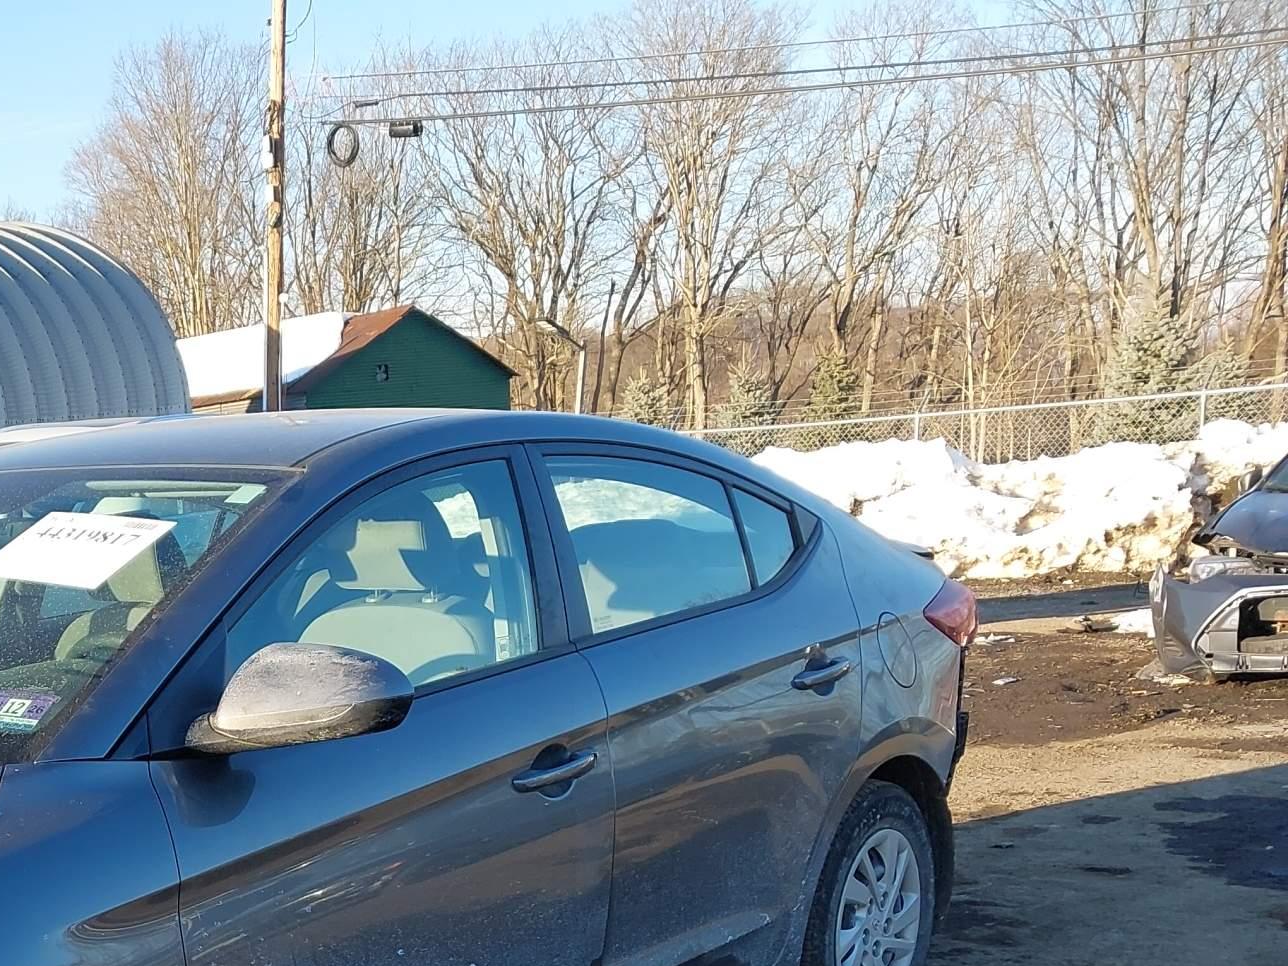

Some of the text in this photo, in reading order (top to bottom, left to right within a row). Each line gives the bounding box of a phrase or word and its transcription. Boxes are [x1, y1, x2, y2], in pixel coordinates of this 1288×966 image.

[36, 526, 142, 546] 44319817
[2, 701, 26, 715] 12
[27, 704, 45, 714] 26
